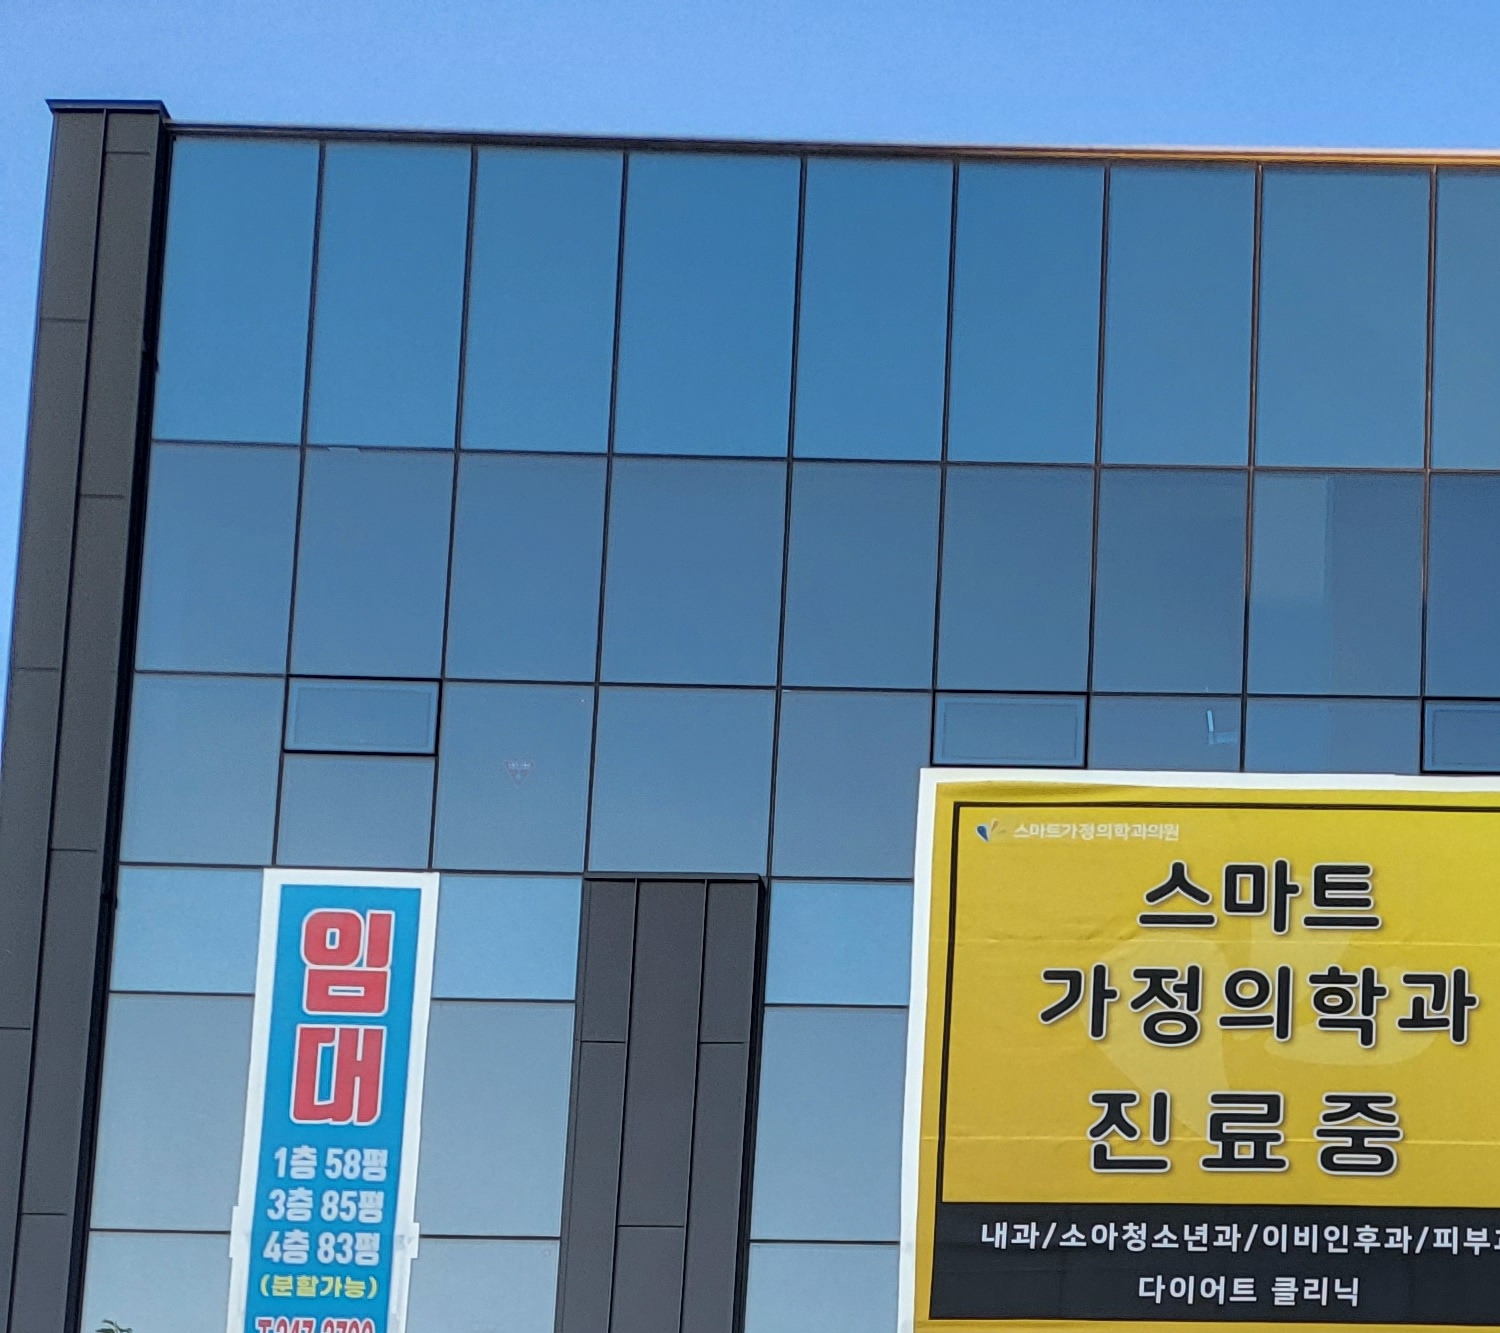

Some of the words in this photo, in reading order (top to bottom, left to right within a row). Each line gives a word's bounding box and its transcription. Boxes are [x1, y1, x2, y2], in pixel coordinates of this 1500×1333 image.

[1013, 822, 1180, 842] 스마트가정의학과의원
[1137, 859, 1382, 934] 스마트
[289, 908, 396, 1127] 임대
[1039, 963, 1479, 1049] 가정의학과
[1087, 1090, 1404, 1177] 진료중
[274, 1145, 318, 1181] 1층
[324, 1146, 390, 1184] 58평
[267, 1188, 314, 1224] 3층
[320, 1189, 386, 1226] 85평
[262, 1231, 310, 1266] 4층
[315, 1231, 381, 1268] 83평
[259, 1274, 379, 1300] (분할가능)
[1138, 1276, 1258, 1305] 다이어트
[1271, 1277, 1361, 1307] 클리닉
